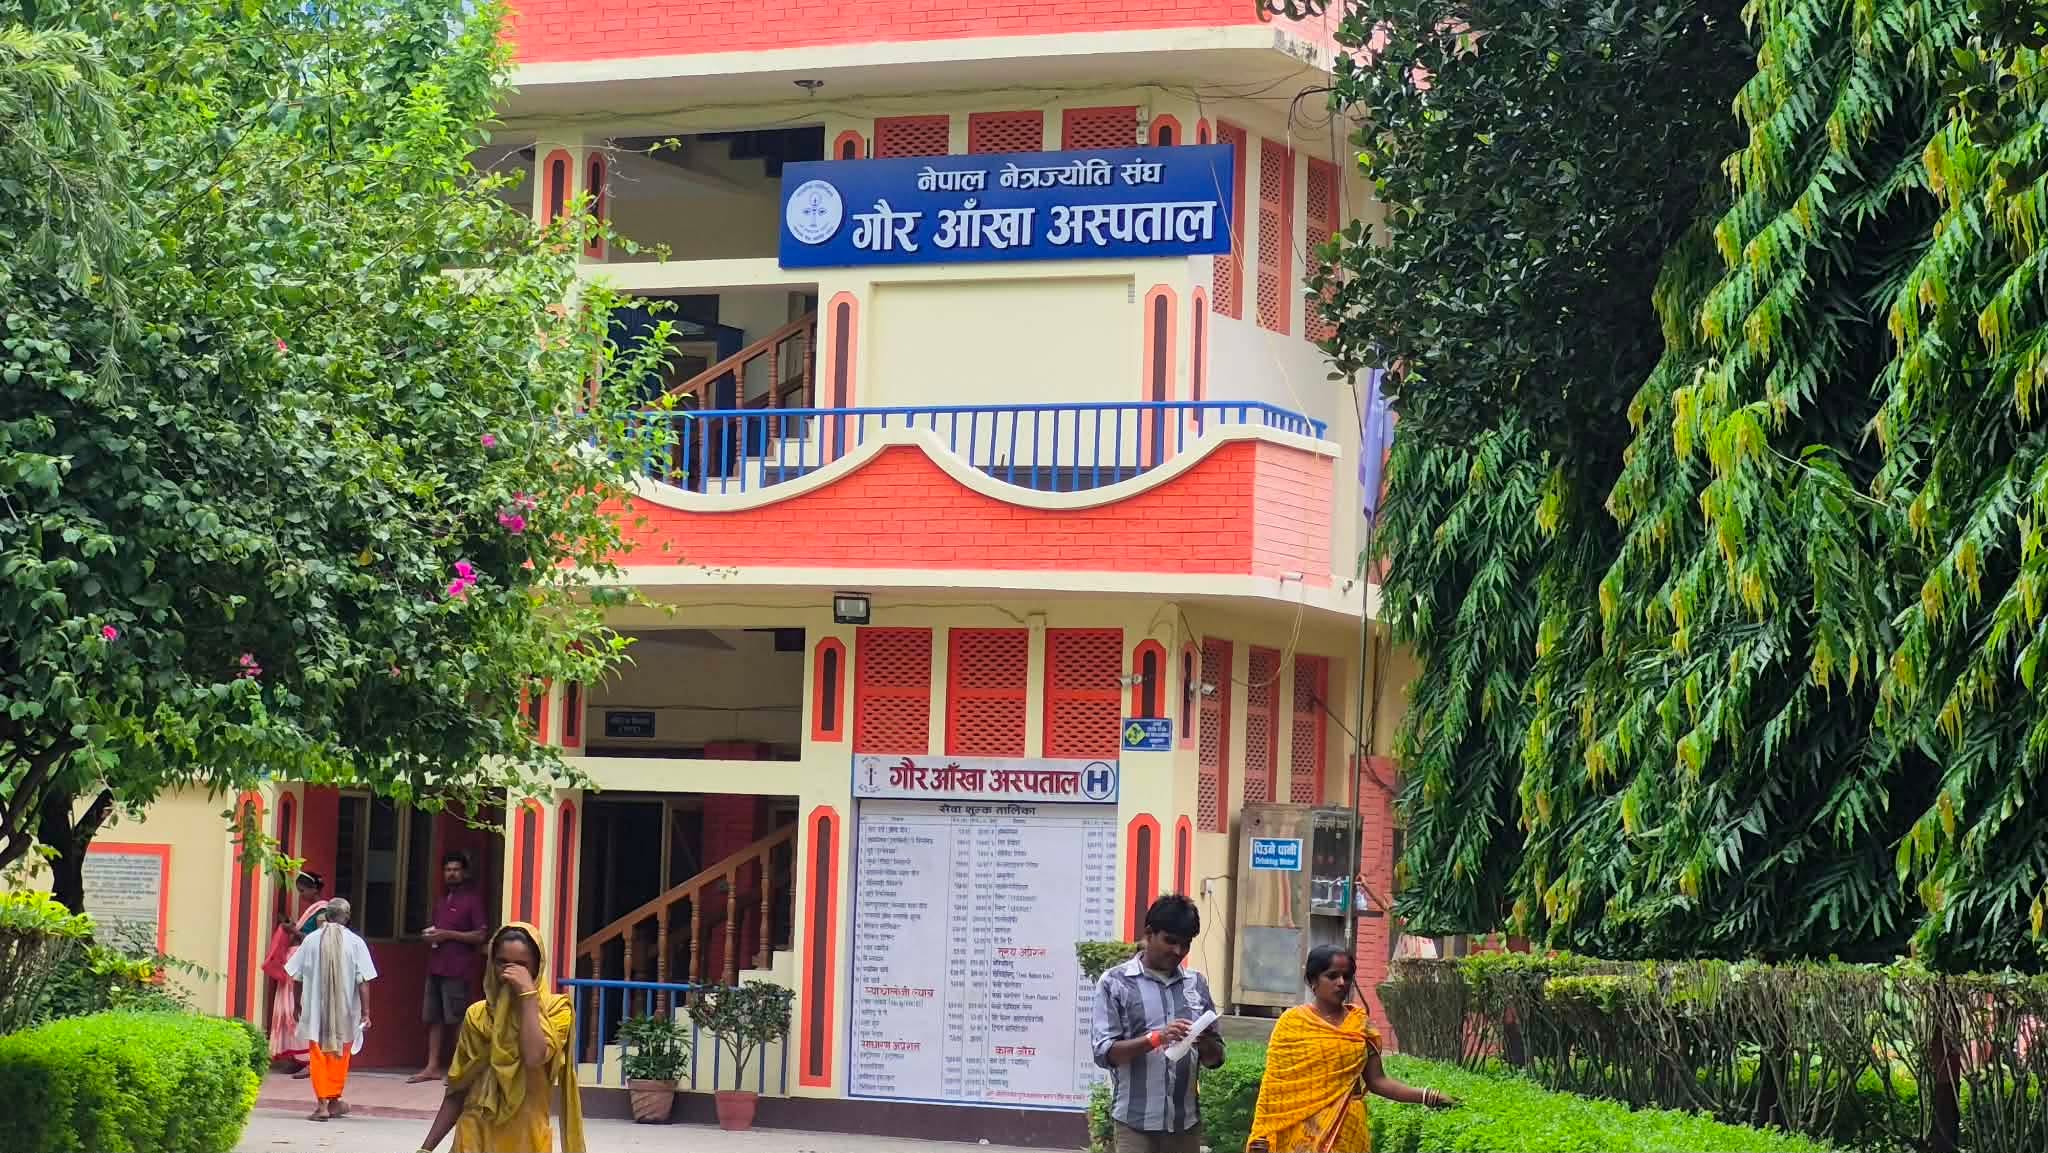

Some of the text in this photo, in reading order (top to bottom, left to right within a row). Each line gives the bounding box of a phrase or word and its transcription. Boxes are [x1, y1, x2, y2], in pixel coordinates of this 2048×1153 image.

[917, 159, 1162, 191] नेपाल नेत्रज्योति संघ
[852, 199, 922, 252] गौर
[933, 197, 1036, 249] आँखा
[1046, 200, 1217, 247] अस्पताल
[889, 757, 928, 791] गौर
[930, 762, 984, 792] आँखा
[989, 768, 1079, 794] अस्पताल
[1087, 770, 1108, 792] H
[938, 804, 1036, 816] सेवा शुल्क तालिका
